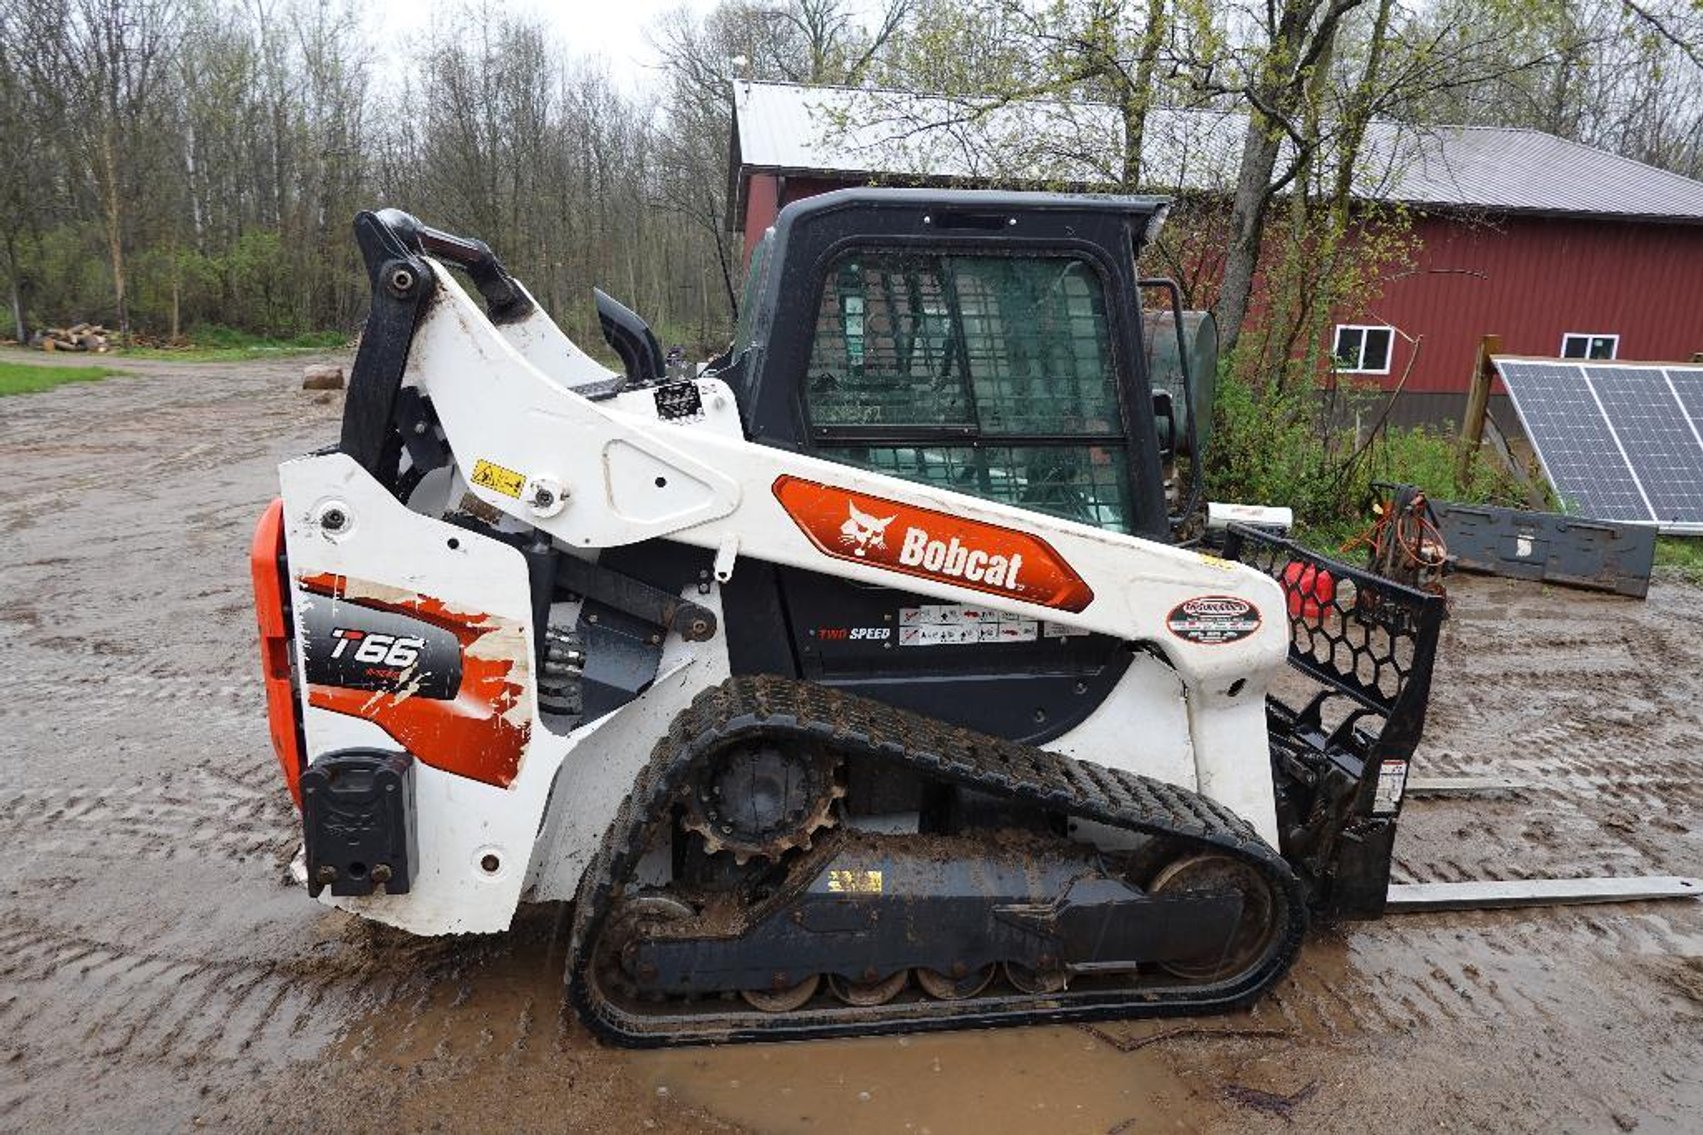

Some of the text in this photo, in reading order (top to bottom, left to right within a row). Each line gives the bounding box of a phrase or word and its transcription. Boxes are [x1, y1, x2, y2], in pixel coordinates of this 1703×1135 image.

[899, 527, 1023, 590] Bobcat
[330, 629, 425, 667] T66
[818, 628, 890, 640] TWO SPEED
